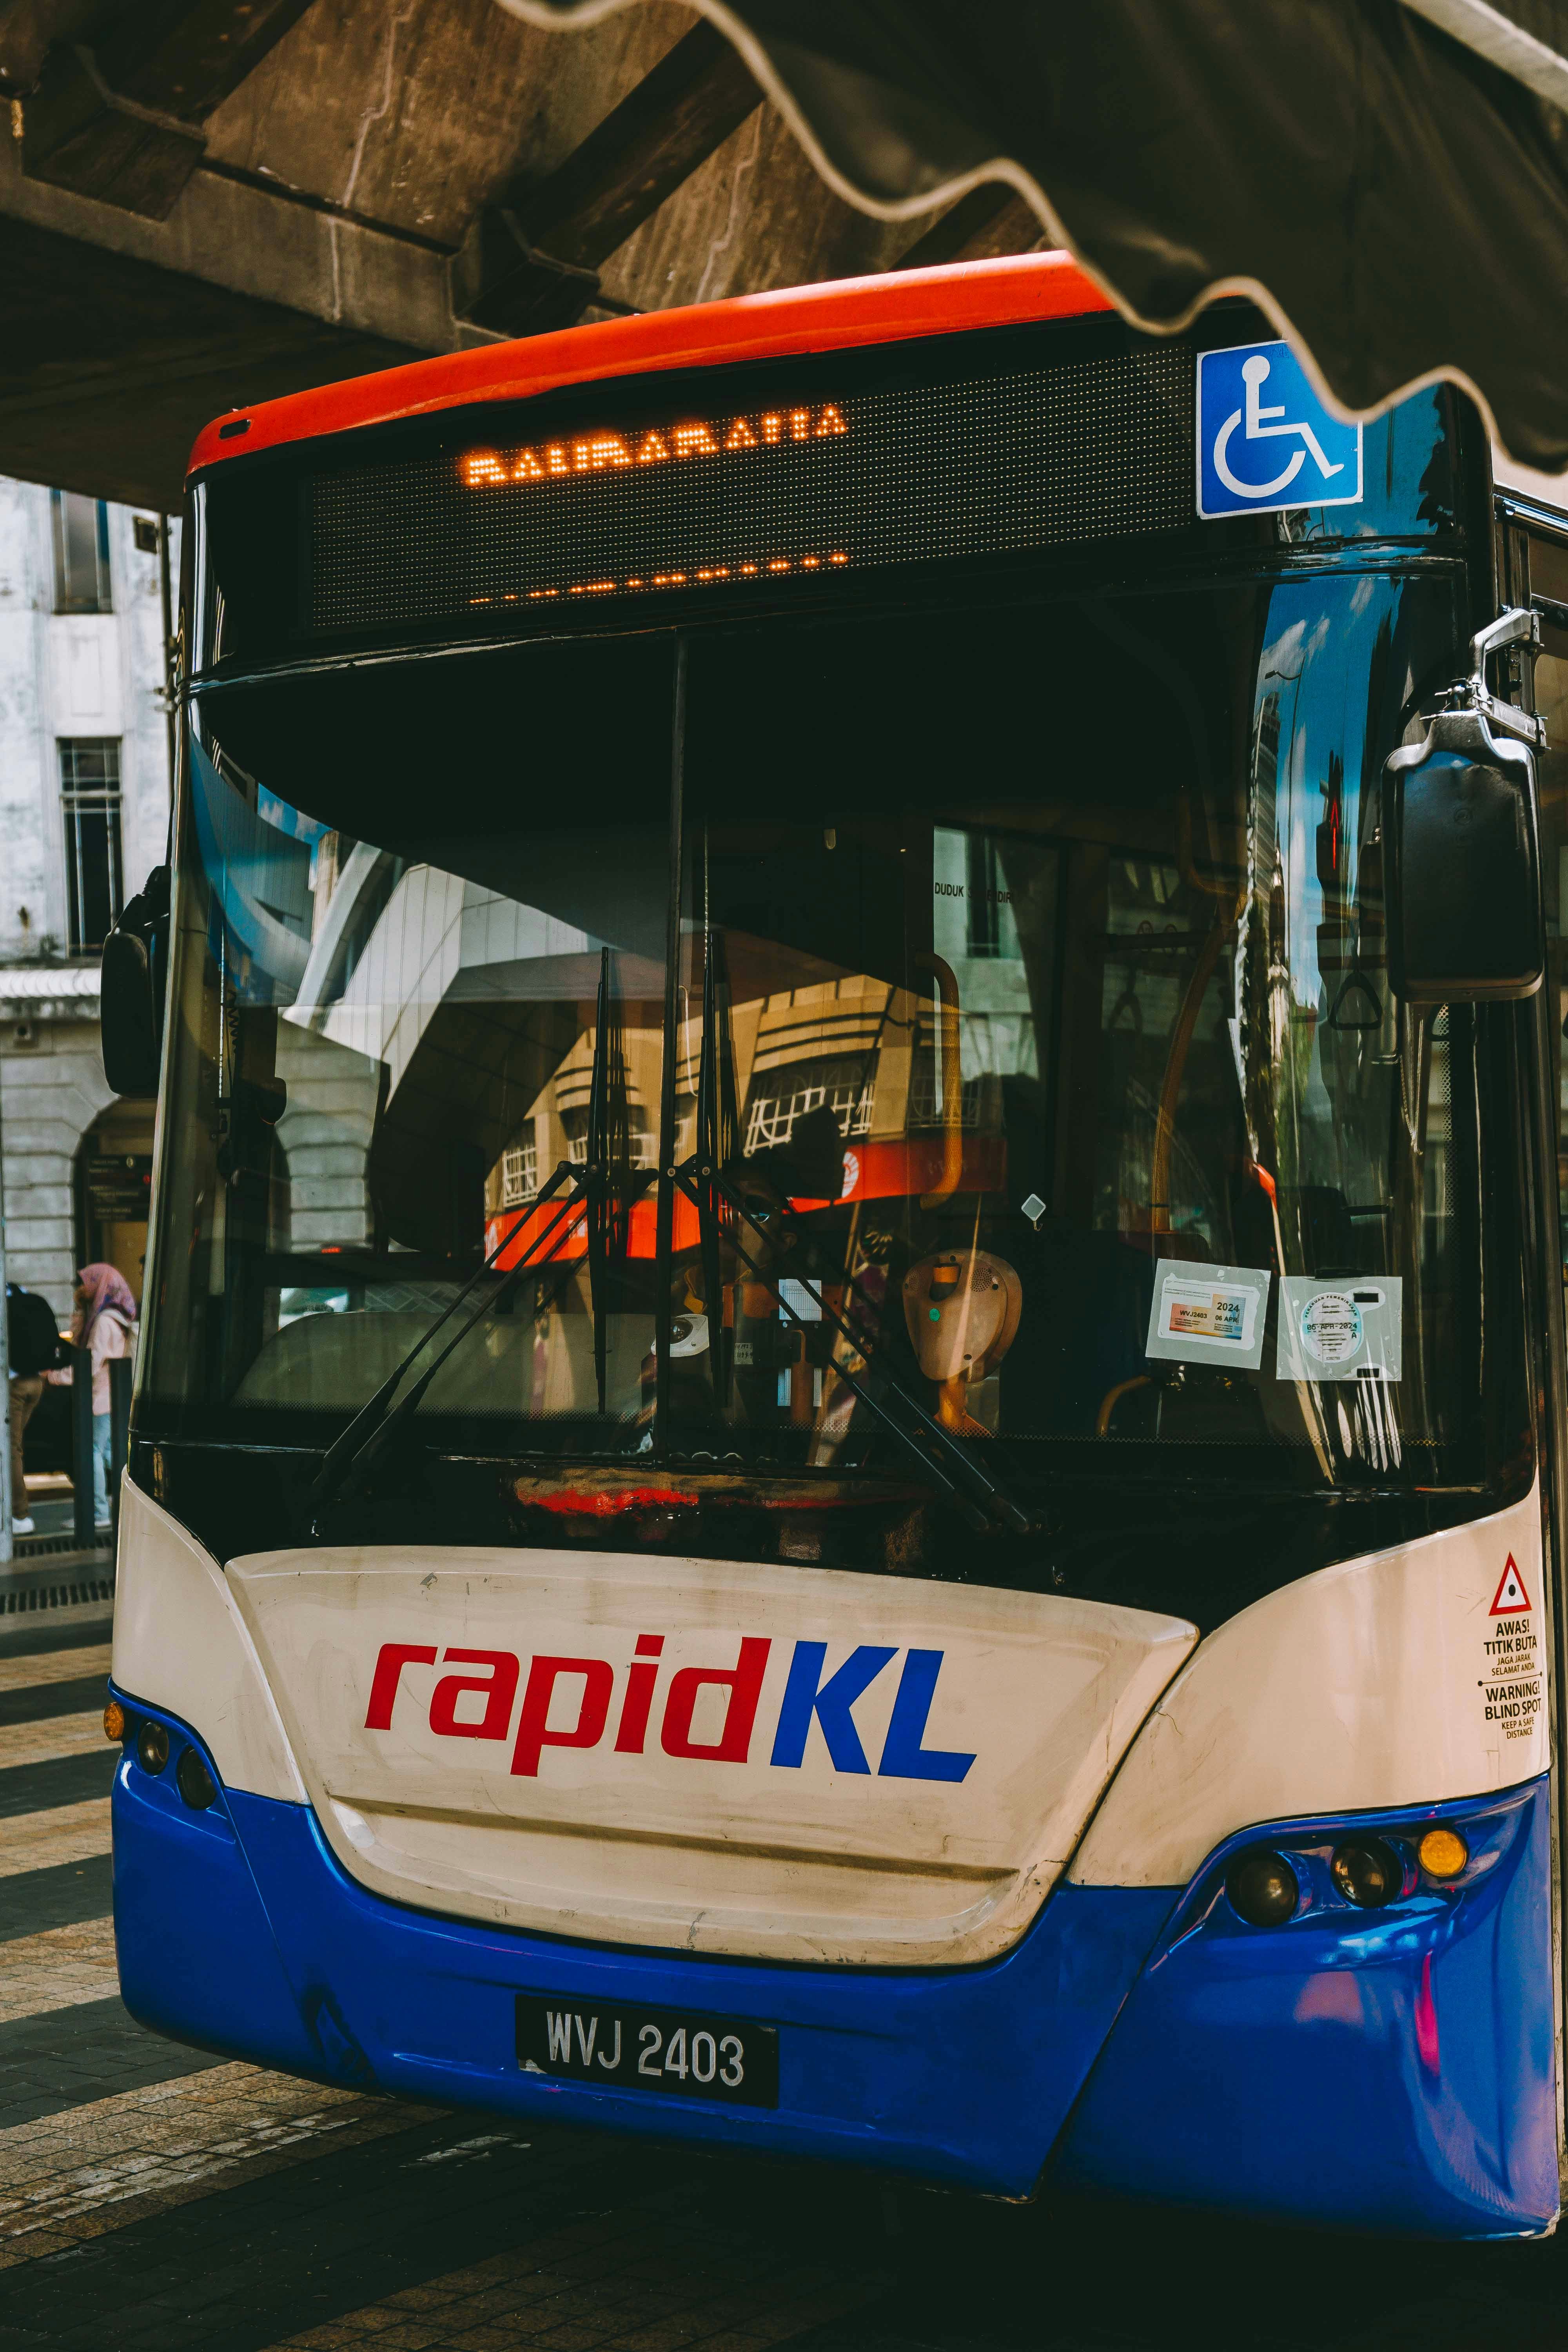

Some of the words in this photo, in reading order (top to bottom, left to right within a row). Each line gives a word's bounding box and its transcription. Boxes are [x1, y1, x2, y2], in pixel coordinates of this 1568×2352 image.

[935, 882, 964, 897] DUDUK
[1217, 1302, 1239, 1312] 2024
[1180, 1310, 1207, 1319] WVJ2403
[1496, 1619, 1530, 1637] AWAS!
[1484, 1639, 1514, 1655] TITIK
[1515, 1635, 1537, 1651] BUTA
[1497, 1656, 1514, 1665] JAGA
[1515, 1653, 1530, 1663] JARAK
[1492, 1664, 1520, 1676] SELAMAT
[1521, 1662, 1535, 1672] ANDA
[1485, 1681, 1540, 1702] WARNING!
[1485, 1703, 1520, 1720] BLIND
[1522, 1698, 1541, 1715] SPOT
[1501, 1720, 1517, 1730] KEEP
[1523, 1717, 1534, 1726] SAFE
[1506, 1727, 1533, 1739] DISTANCE
[546, 2011, 621, 2070] WVJ
[638, 2025, 745, 2087] 2403
